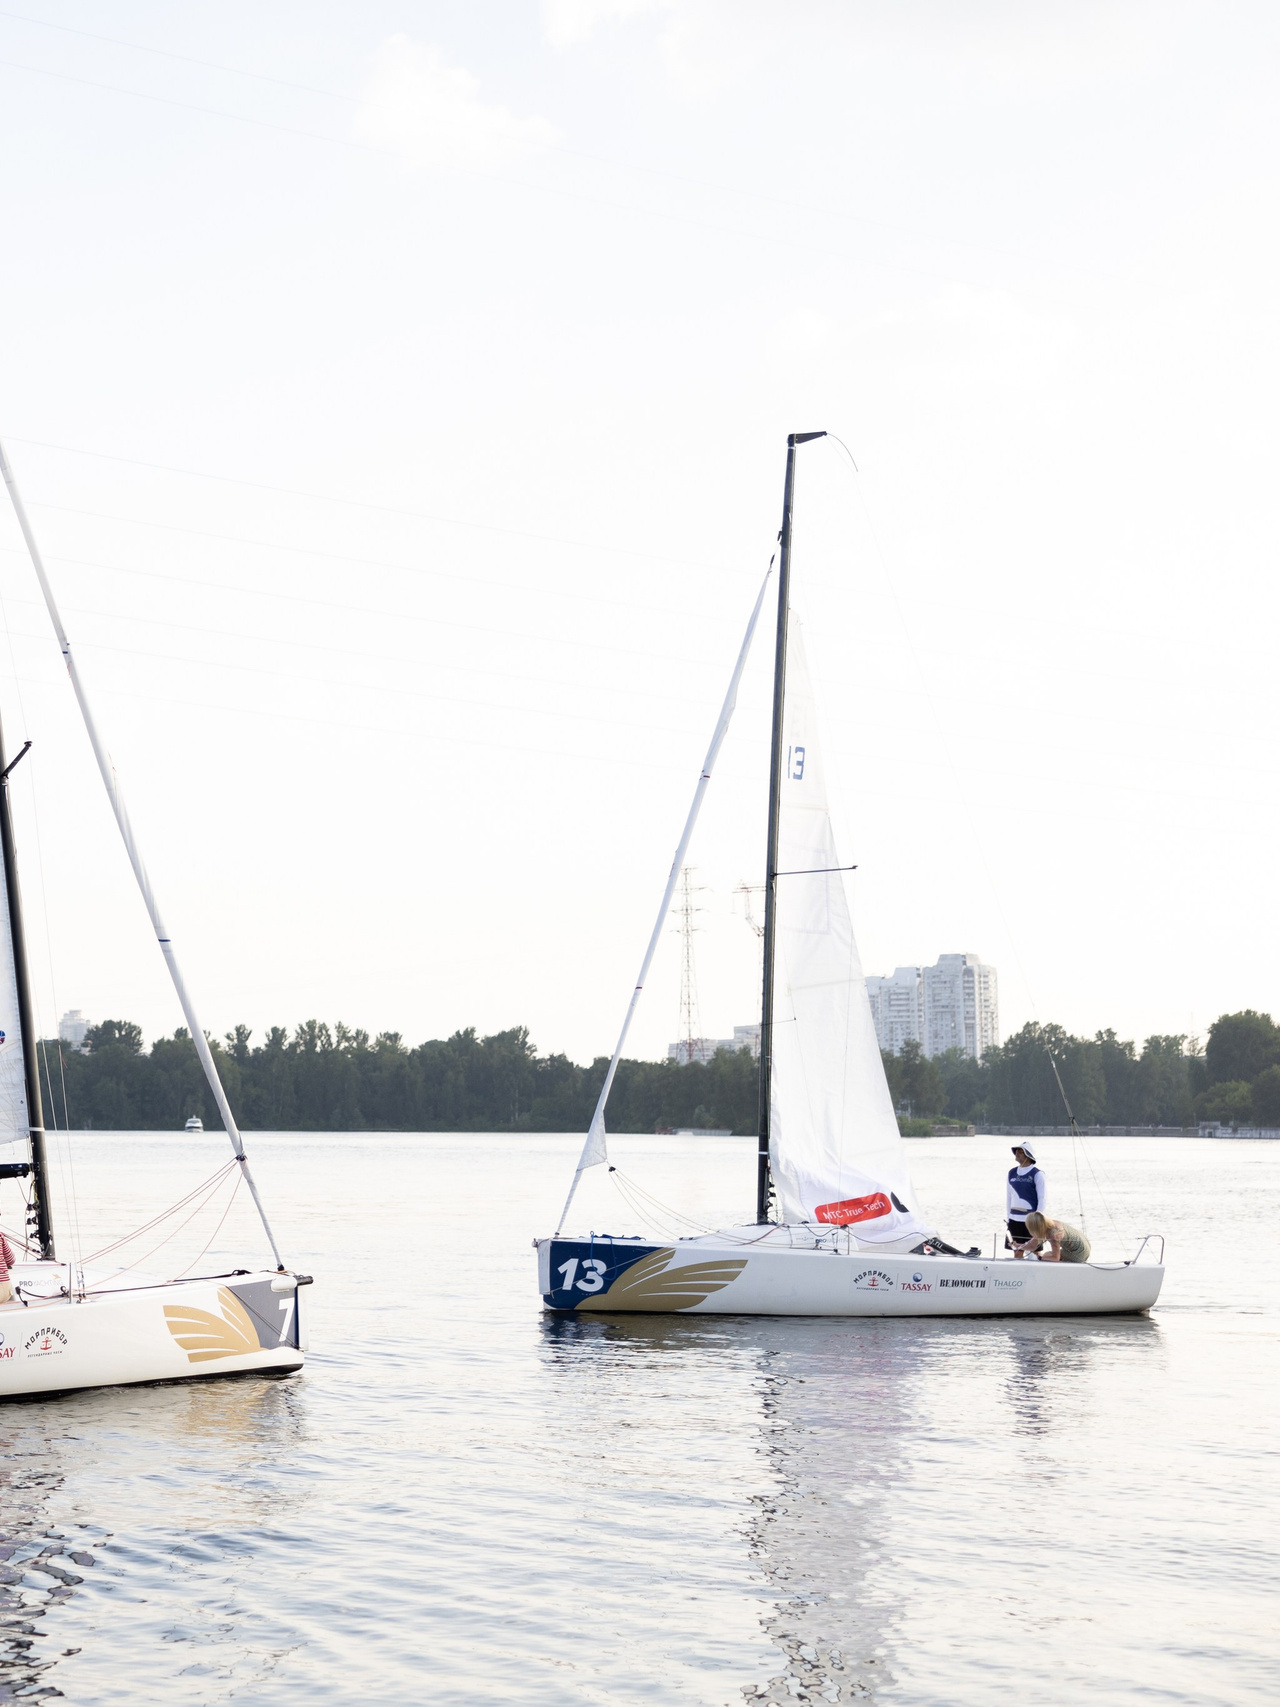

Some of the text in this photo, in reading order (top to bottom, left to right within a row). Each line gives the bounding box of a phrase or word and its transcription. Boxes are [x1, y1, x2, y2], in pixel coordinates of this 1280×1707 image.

[843, 1207, 864, 1217] True
[864, 1200, 885, 1211] Tech
[557, 1258, 607, 1292] 13
[853, 1270, 894, 1286] МОРПРИБОР
[901, 1282, 932, 1292] TASSAY
[278, 1296, 295, 1342] 7
[24, 1326, 68, 1350] МОРПРИБОР
